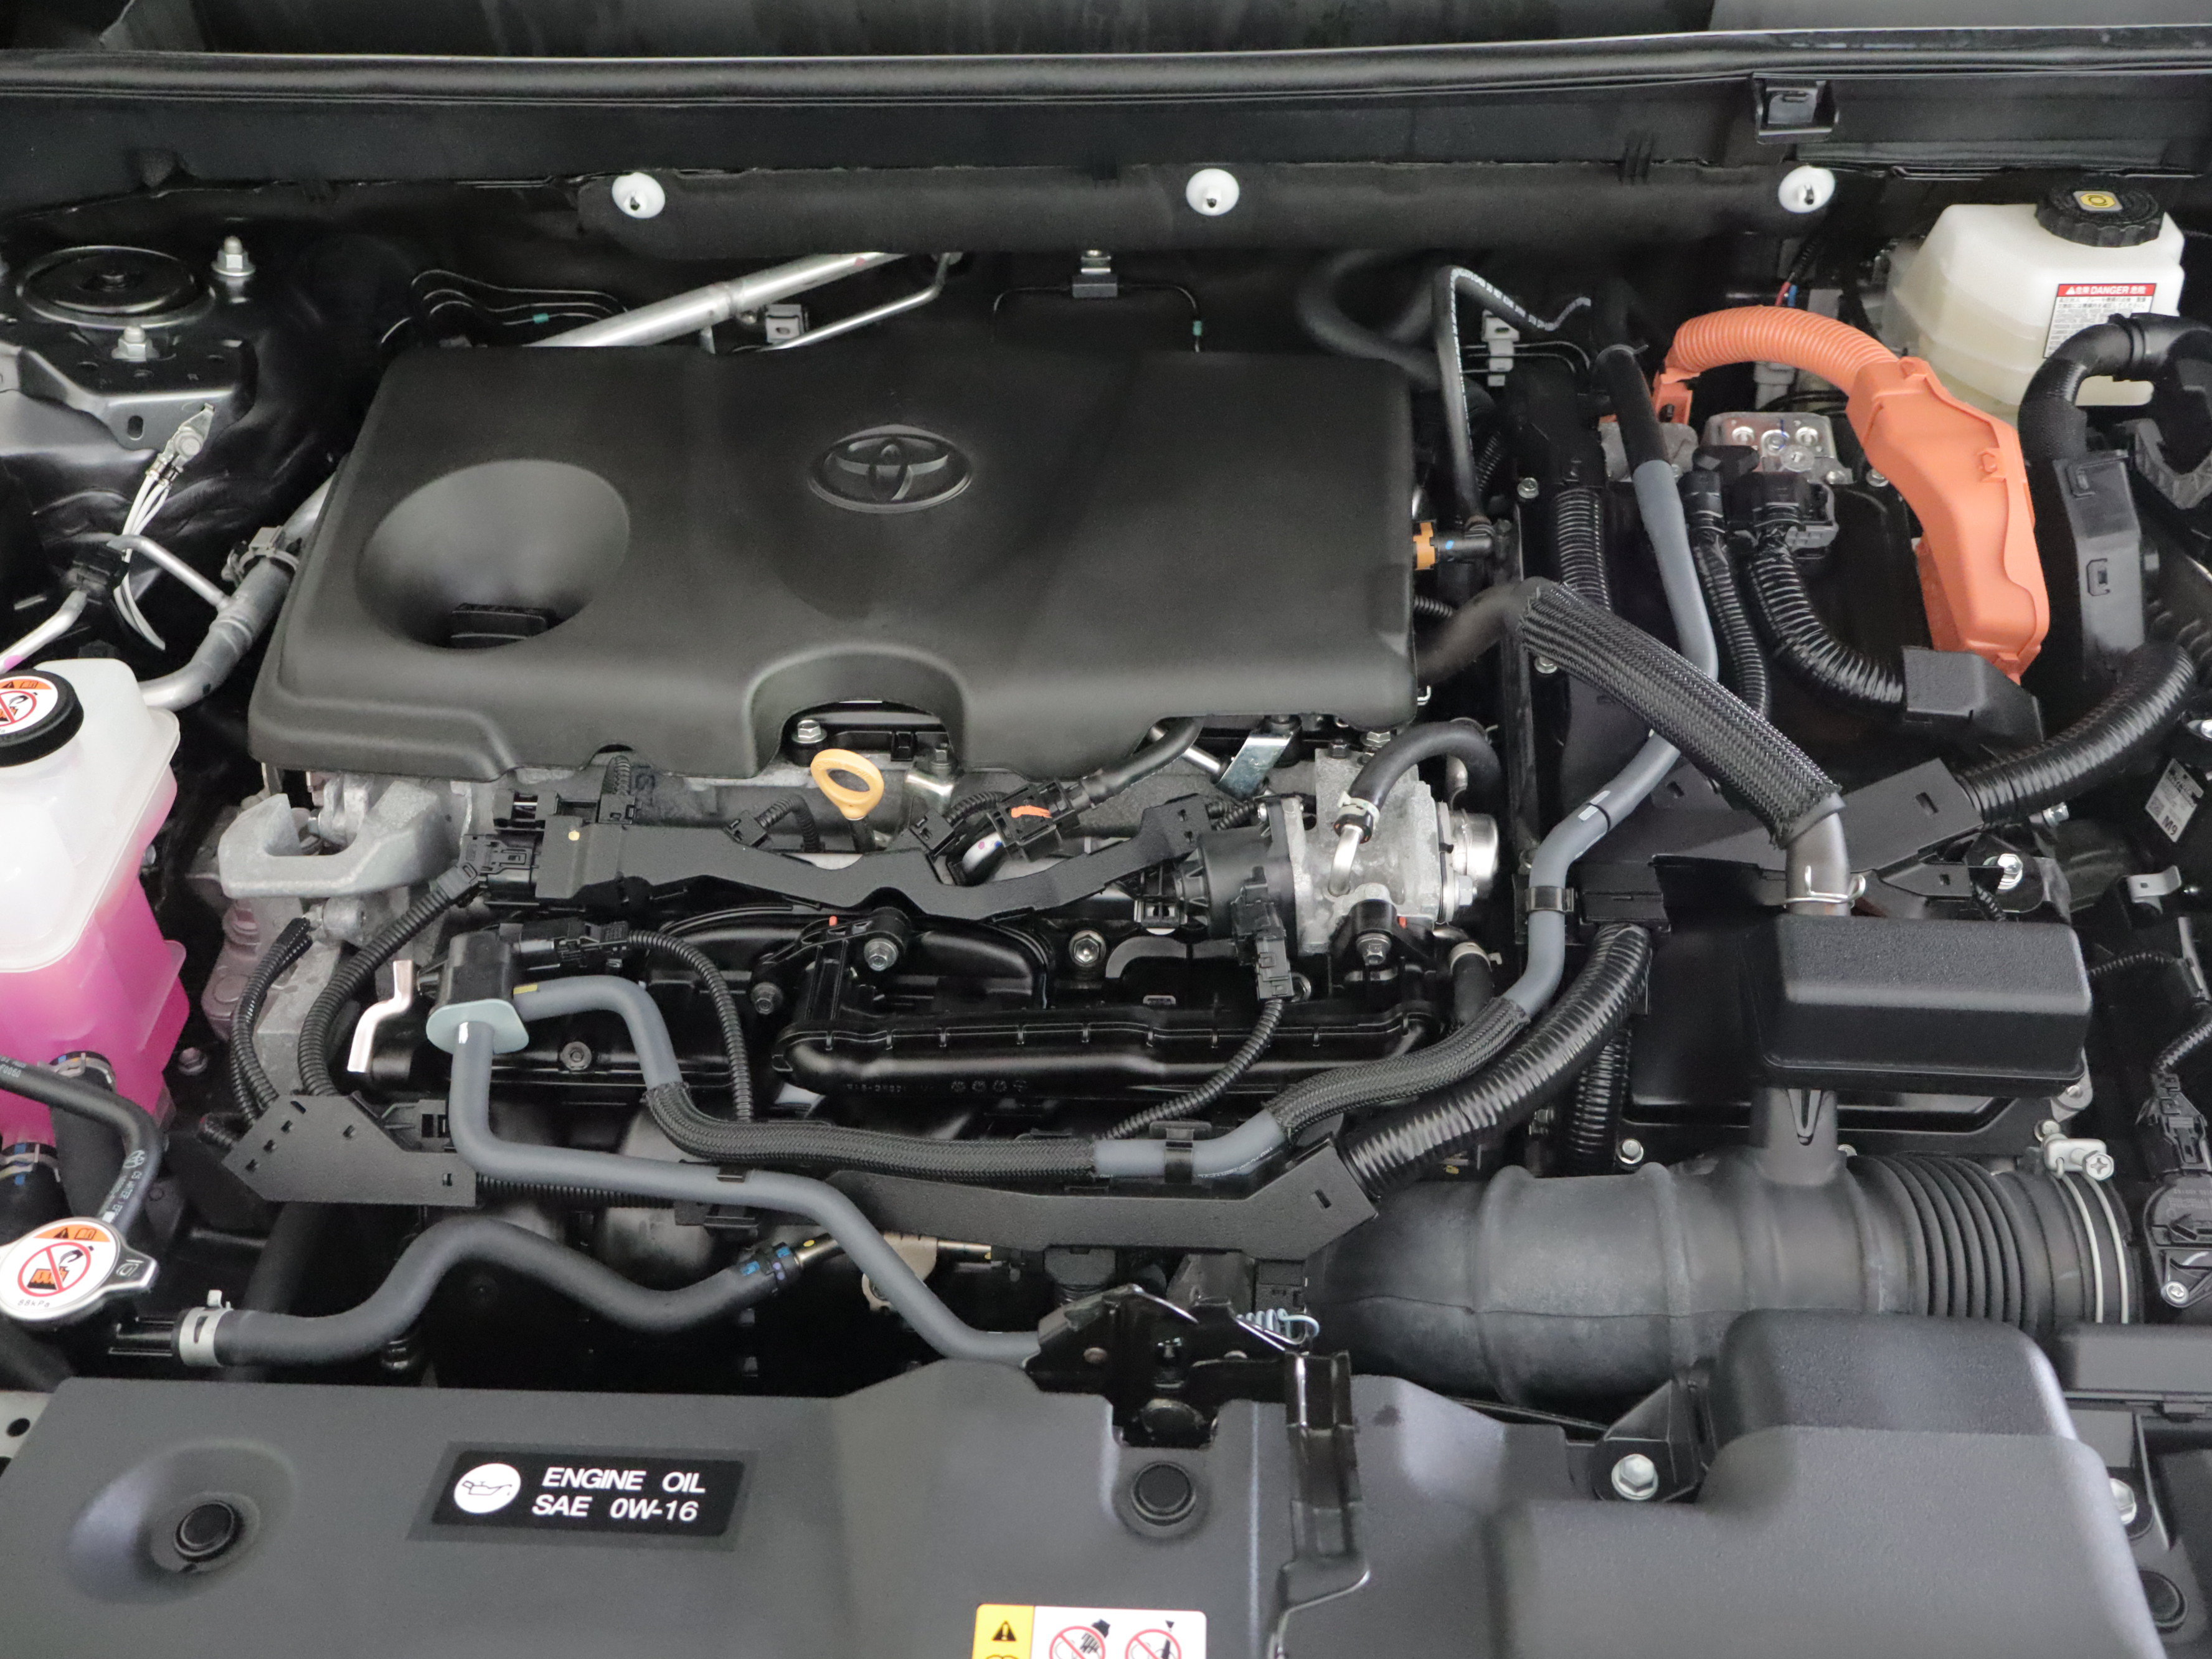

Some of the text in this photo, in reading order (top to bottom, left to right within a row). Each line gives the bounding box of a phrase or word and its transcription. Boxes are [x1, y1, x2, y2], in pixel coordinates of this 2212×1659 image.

[2091, 286, 2129, 295] DANGER
[2162, 815, 2178, 836] M9
[17, 1298, 50, 1308] 88kPa
[541, 1467, 706, 1493] ENGINE OIL
[531, 1494, 699, 1522] SAE 0W-16
